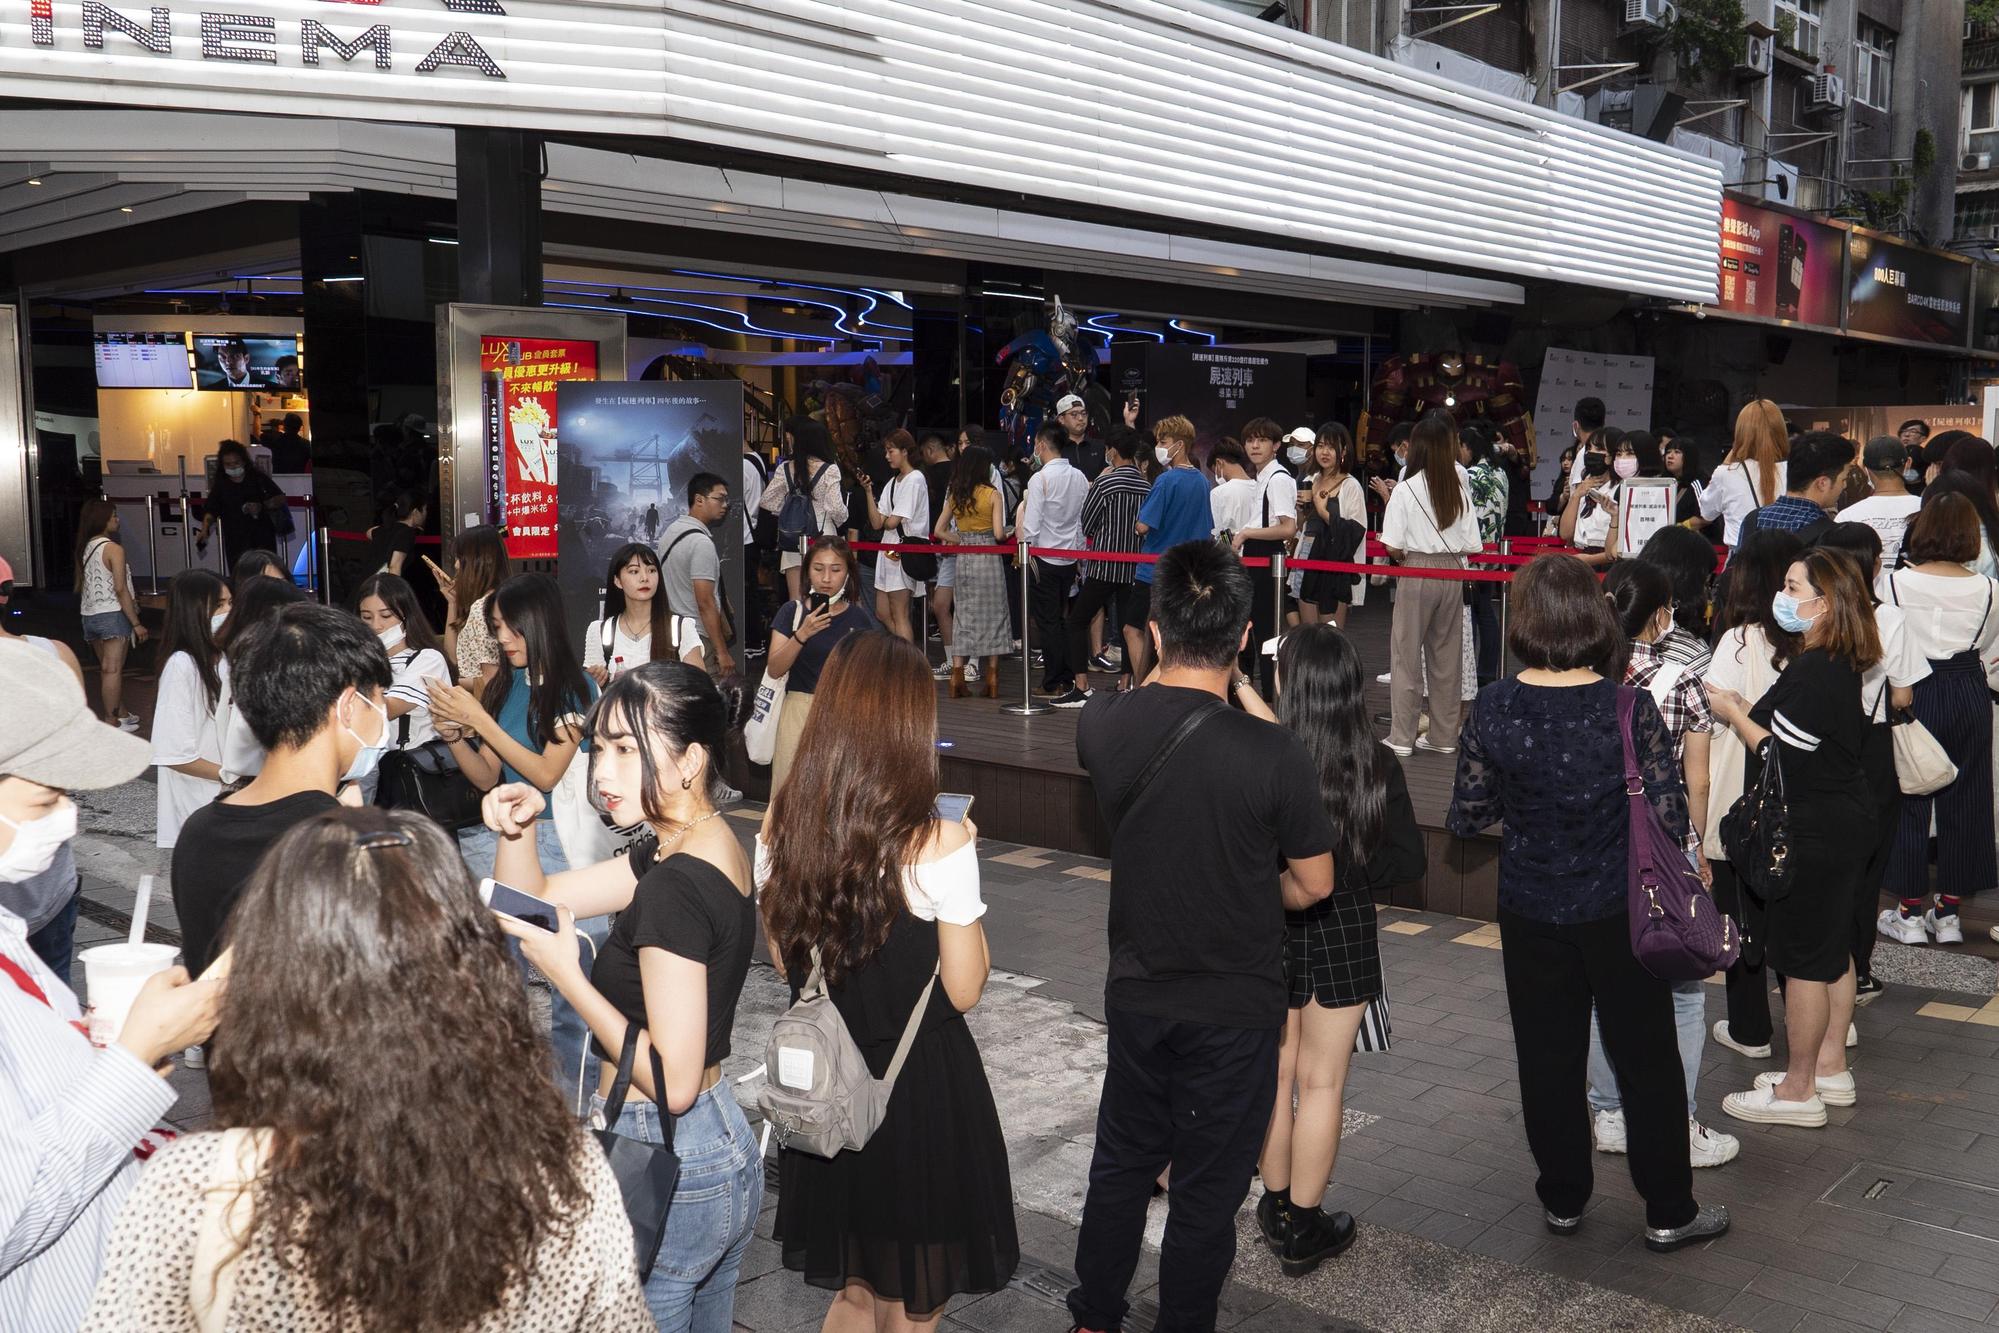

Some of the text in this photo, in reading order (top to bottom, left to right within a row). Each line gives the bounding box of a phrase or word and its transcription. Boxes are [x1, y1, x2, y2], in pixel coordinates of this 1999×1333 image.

[491, 362, 579, 379] 員優惠更升級！
[1210, 366, 1254, 387] 屍速列車
[506, 491, 542, 505] 杯飲料
[512, 526, 550, 536] 會員限定
